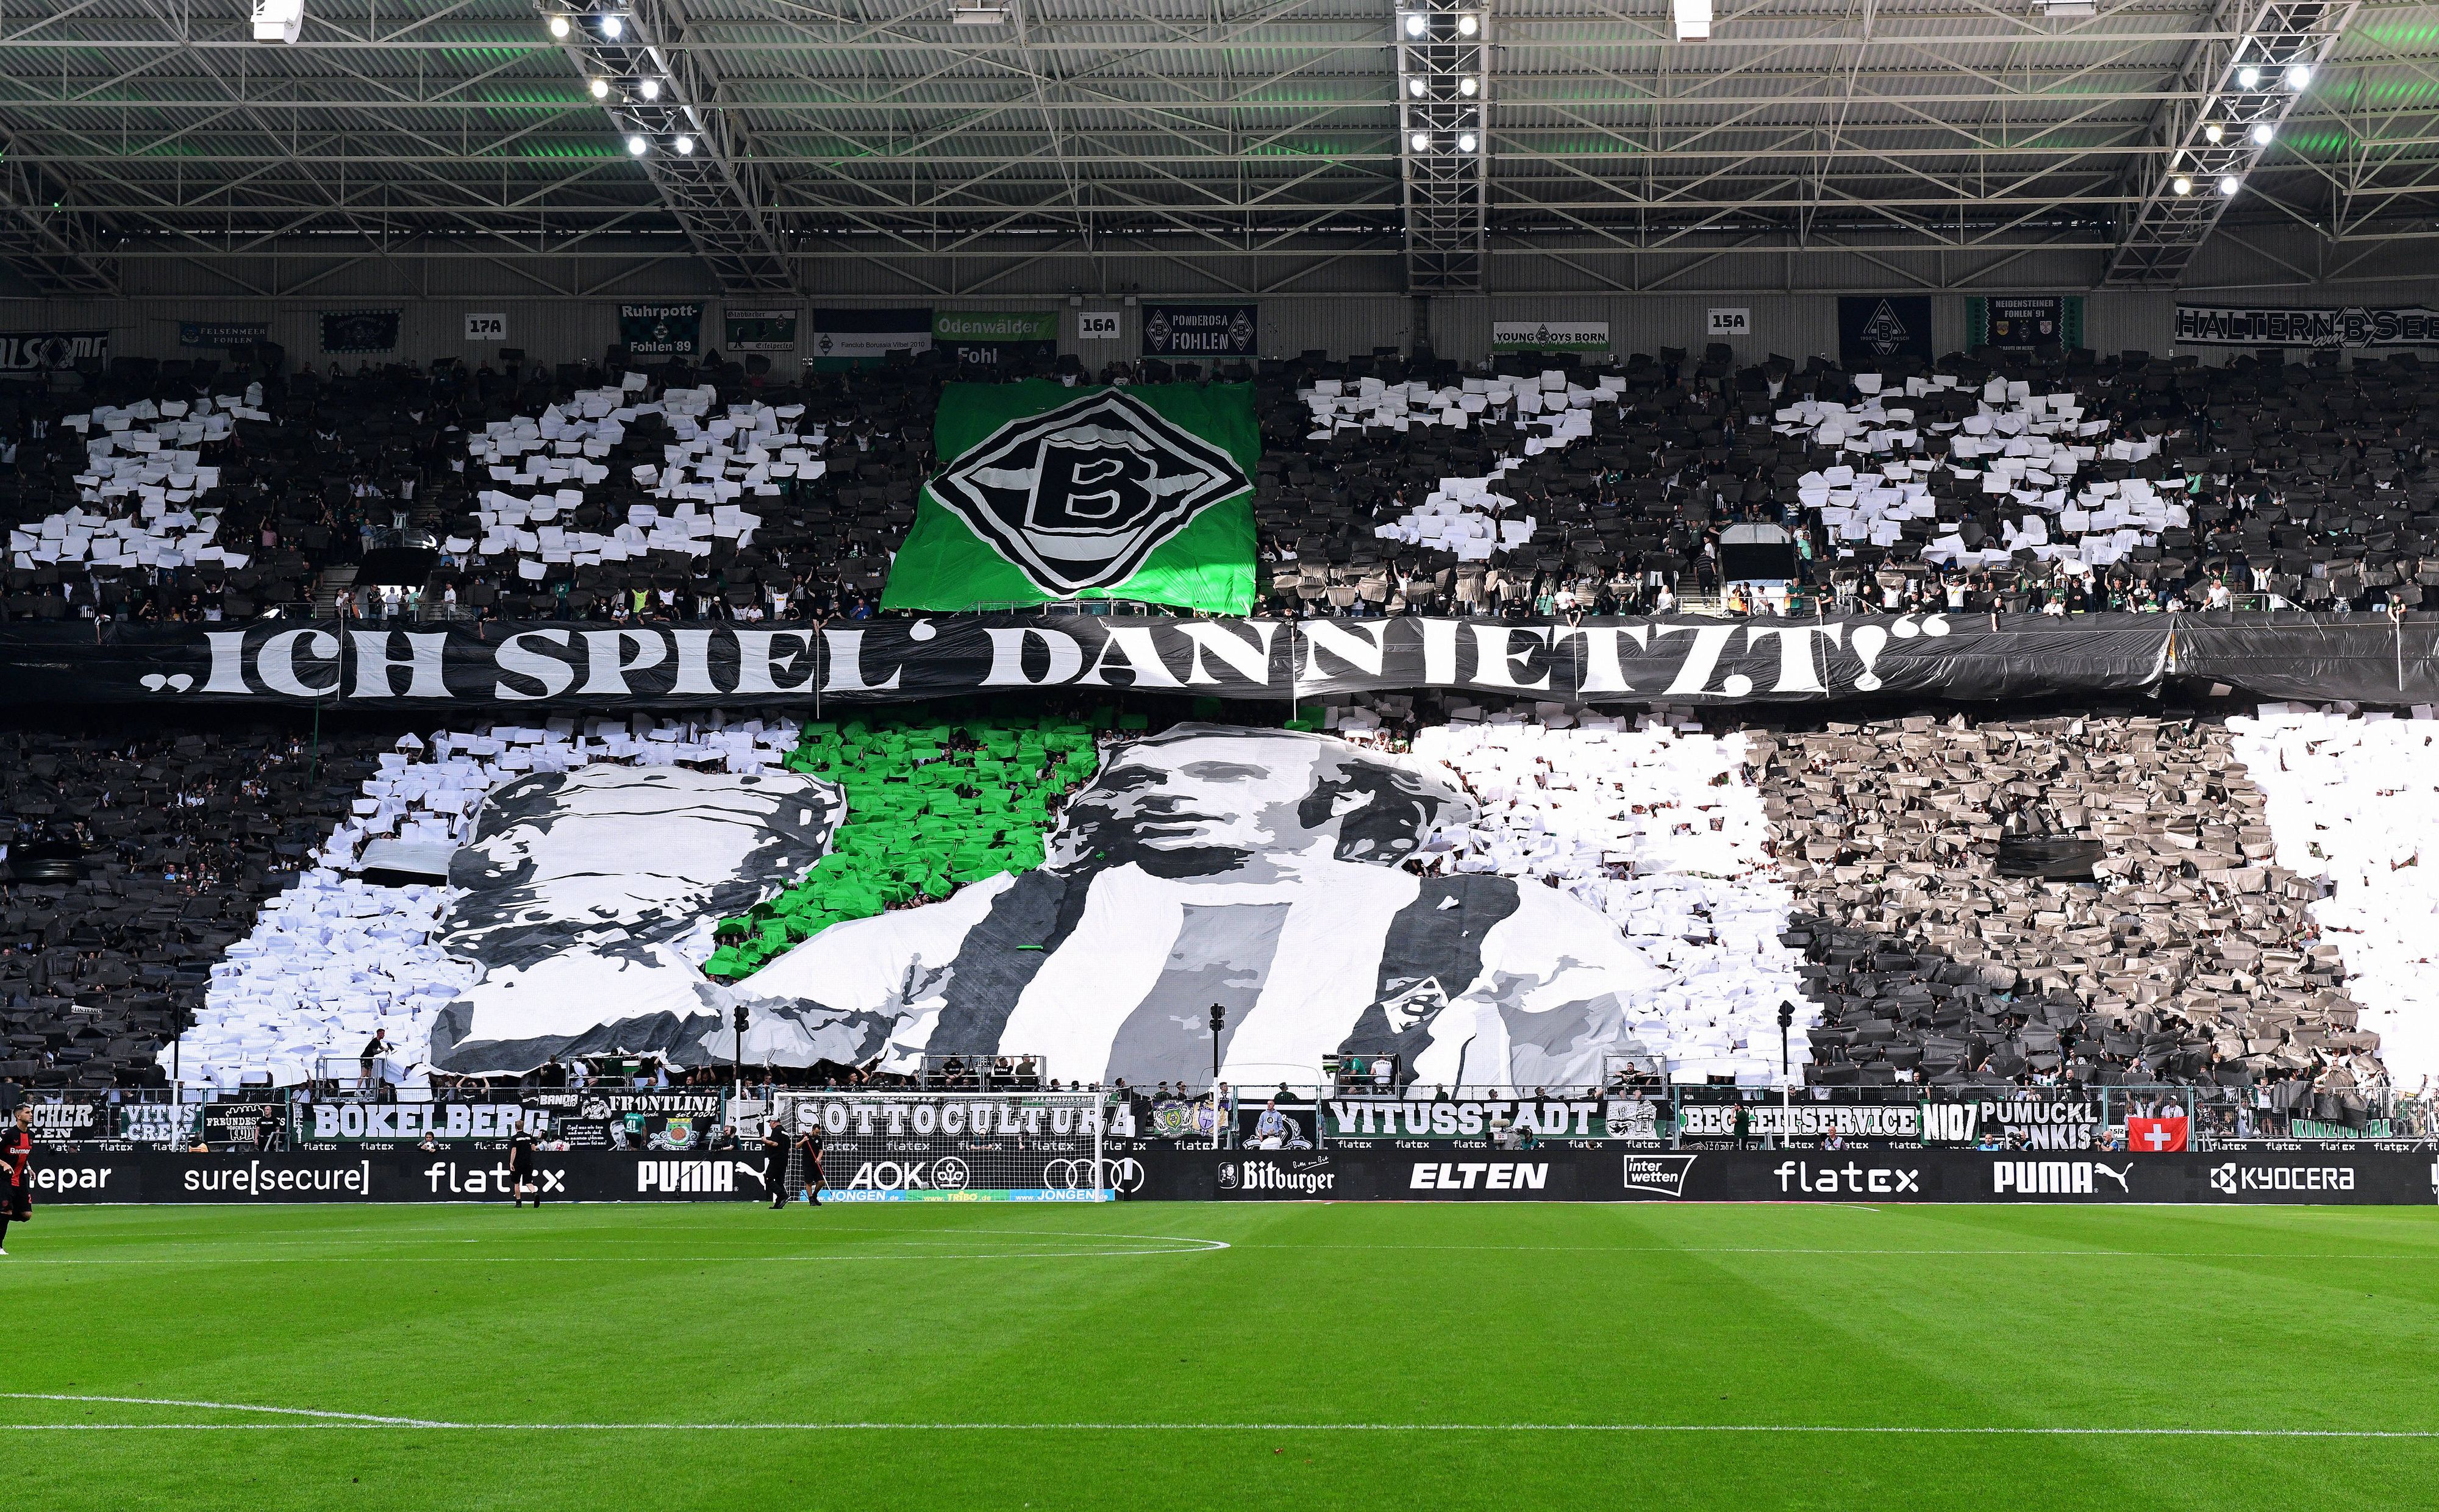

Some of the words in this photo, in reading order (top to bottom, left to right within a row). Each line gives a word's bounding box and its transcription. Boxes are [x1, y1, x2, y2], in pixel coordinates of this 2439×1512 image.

[622, 305, 697, 319] Ruhrpott-
[470, 320, 501, 332] 17A
[938, 318, 1038, 334] Odenwälder
[1084, 319, 1115, 332] 16A
[1173, 315, 1228, 326] PONDEROSA
[1713, 315, 1744, 327] 15A
[2177, 309, 2335, 341] HALTERN
[630, 341, 673, 352] Fohlen
[1173, 333, 1229, 349] FOHLEN
[958, 348, 997, 364] Fohl
[978, 618, 1392, 688] DANN
[540, 1094, 578, 1105] BANDA
[609, 1096, 718, 1111] FRONTLINE
[125, 1104, 197, 1122] VITUS
[796, 1100, 1137, 1135] SOTTOCULTURA
[1329, 1100, 1599, 1135] VITUSSTADT
[1982, 1102, 2098, 1124] PUMUCKL
[207, 1118, 286, 1126] FREUNDESS
[313, 1102, 549, 1138] BÖKELBERG
[627, 1120, 636, 1131] 41
[1683, 1105, 1918, 1135] BEGEITSERVICE
[127, 1123, 194, 1141] CREW
[99, 1143, 133, 1151] flatex
[152, 1143, 185, 1151] flatx
[360, 1142, 394, 1150] flatex
[823, 1141, 859, 1150] latex
[887, 1141, 930, 1150] flatex
[1032, 1141, 1074, 1150] flatex
[1338, 1140, 1372, 1149] flatex
[1395, 1139, 1429, 1149] flatex
[1452, 1139, 1487, 1149] flatex
[1568, 1139, 1602, 1149] flatx
[1626, 1139, 1660, 1149] flatex
[2265, 1142, 2301, 1150] flatex
[1629, 1158, 1662, 1172] inter
[185, 1160, 369, 1195] sure[secure]
[638, 1161, 733, 1192] PUMA
[847, 1161, 926, 1190] AOK
[1241, 1160, 1335, 1194] Bitburger
[1410, 1163, 1549, 1189] ELTEN
[1632, 1171, 1678, 1183] wetten
[1774, 1161, 1919, 1193] flatex
[1994, 1161, 2093, 1193] PUMA
[2241, 1166, 2355, 1189] KYOCERA
[827, 1191, 886, 1201] JONGEN
[1037, 1190, 1096, 1200] JONGEN
